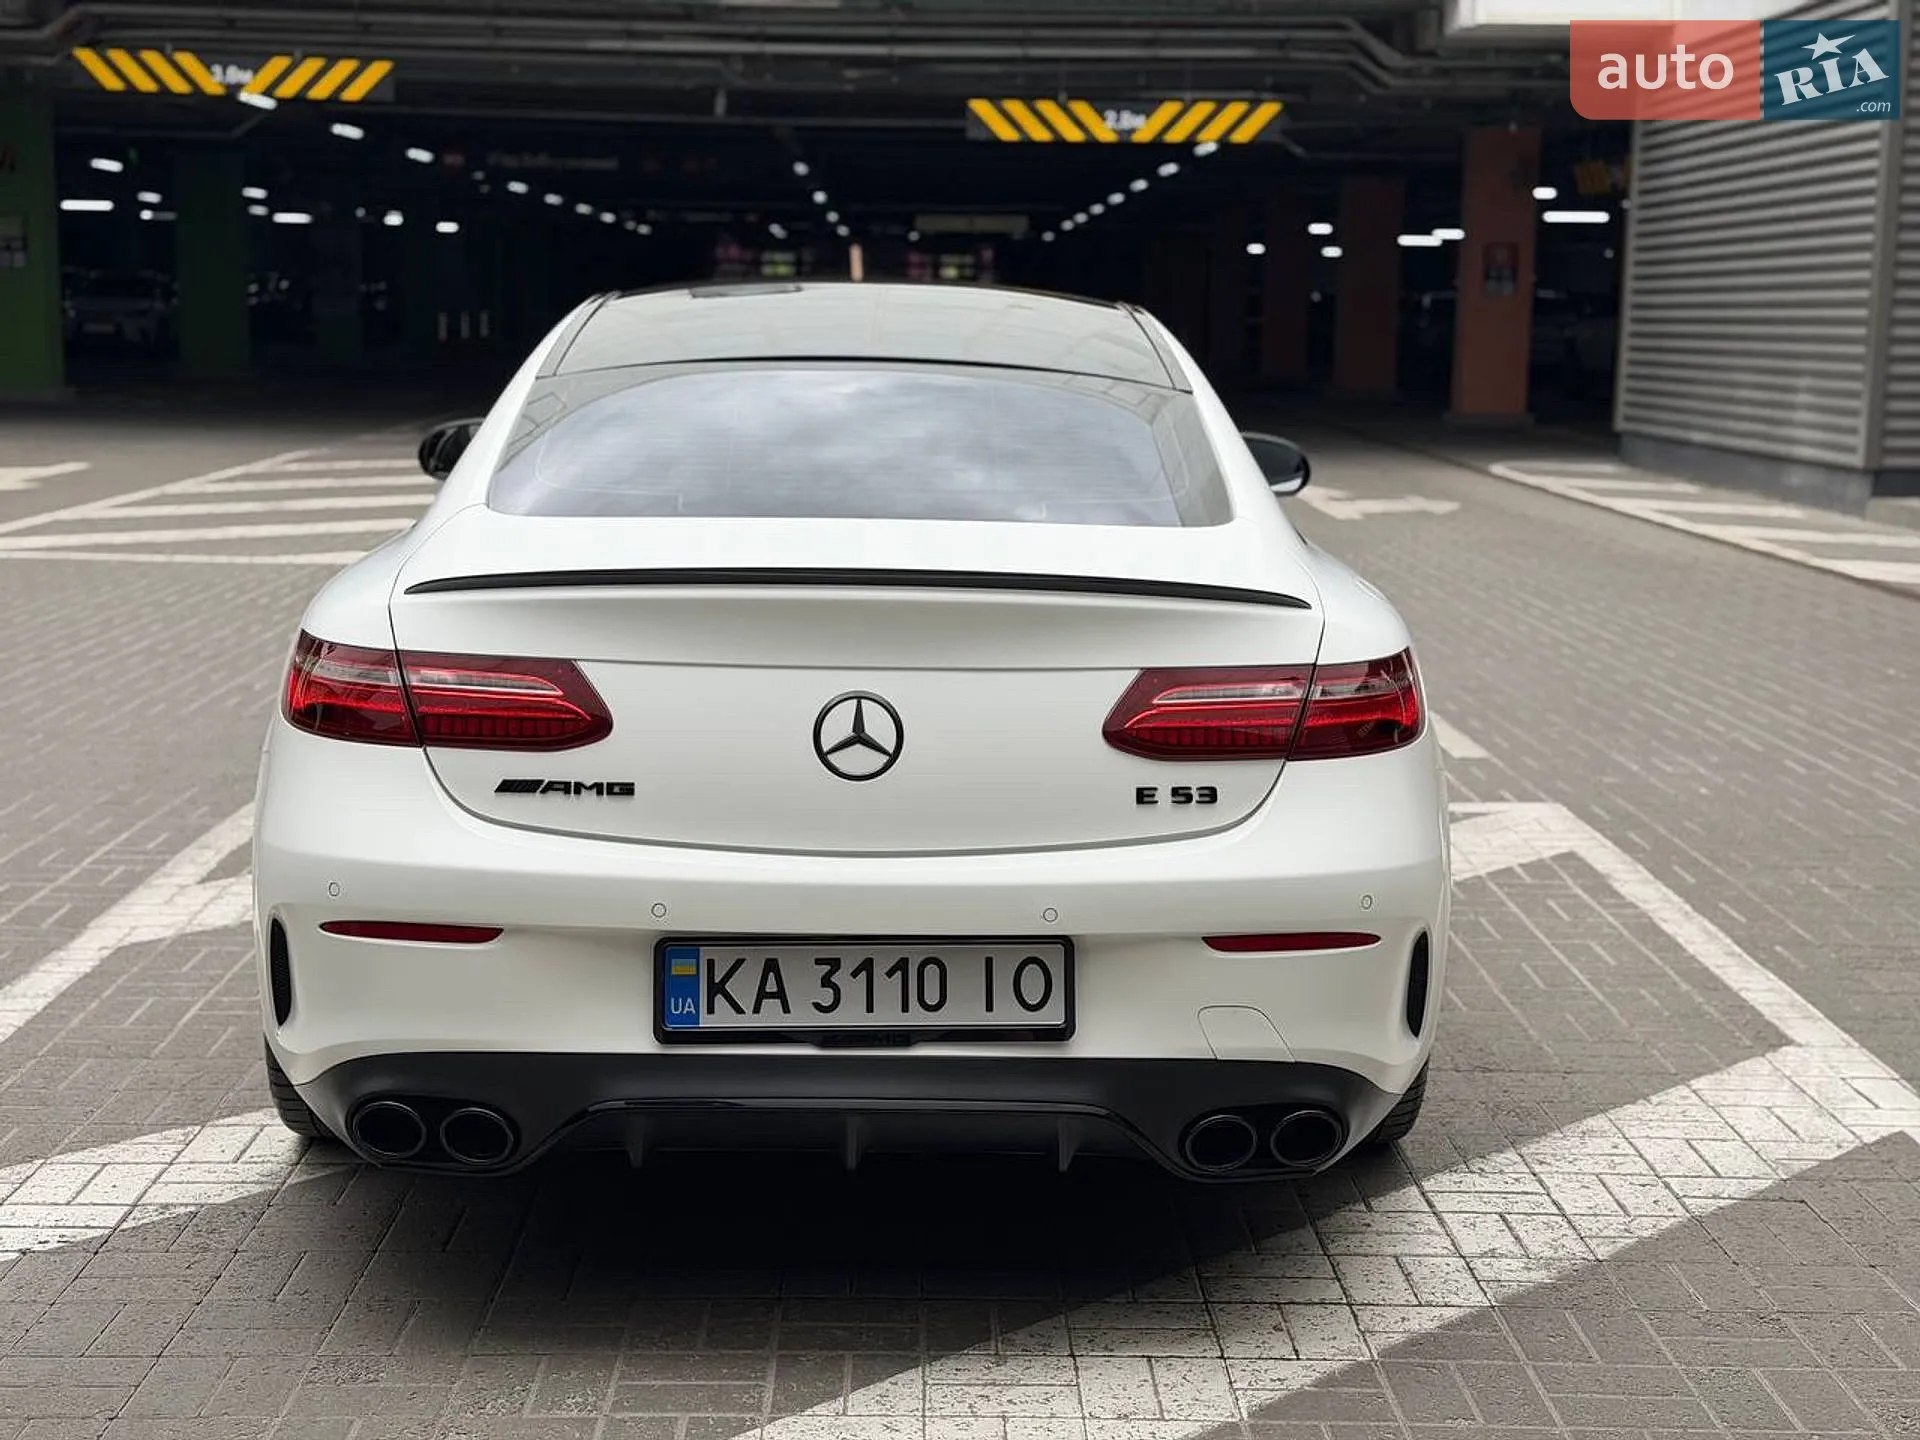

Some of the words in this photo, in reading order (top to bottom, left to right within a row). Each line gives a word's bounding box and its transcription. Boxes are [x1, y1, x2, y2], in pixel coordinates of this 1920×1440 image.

[540, 780, 635, 796] AMG
[1136, 787, 1159, 805] E
[1171, 786, 1218, 804] 53
[706, 957, 791, 1015] KA
[811, 957, 948, 1014] 3110
[671, 997, 696, 1014] UA
